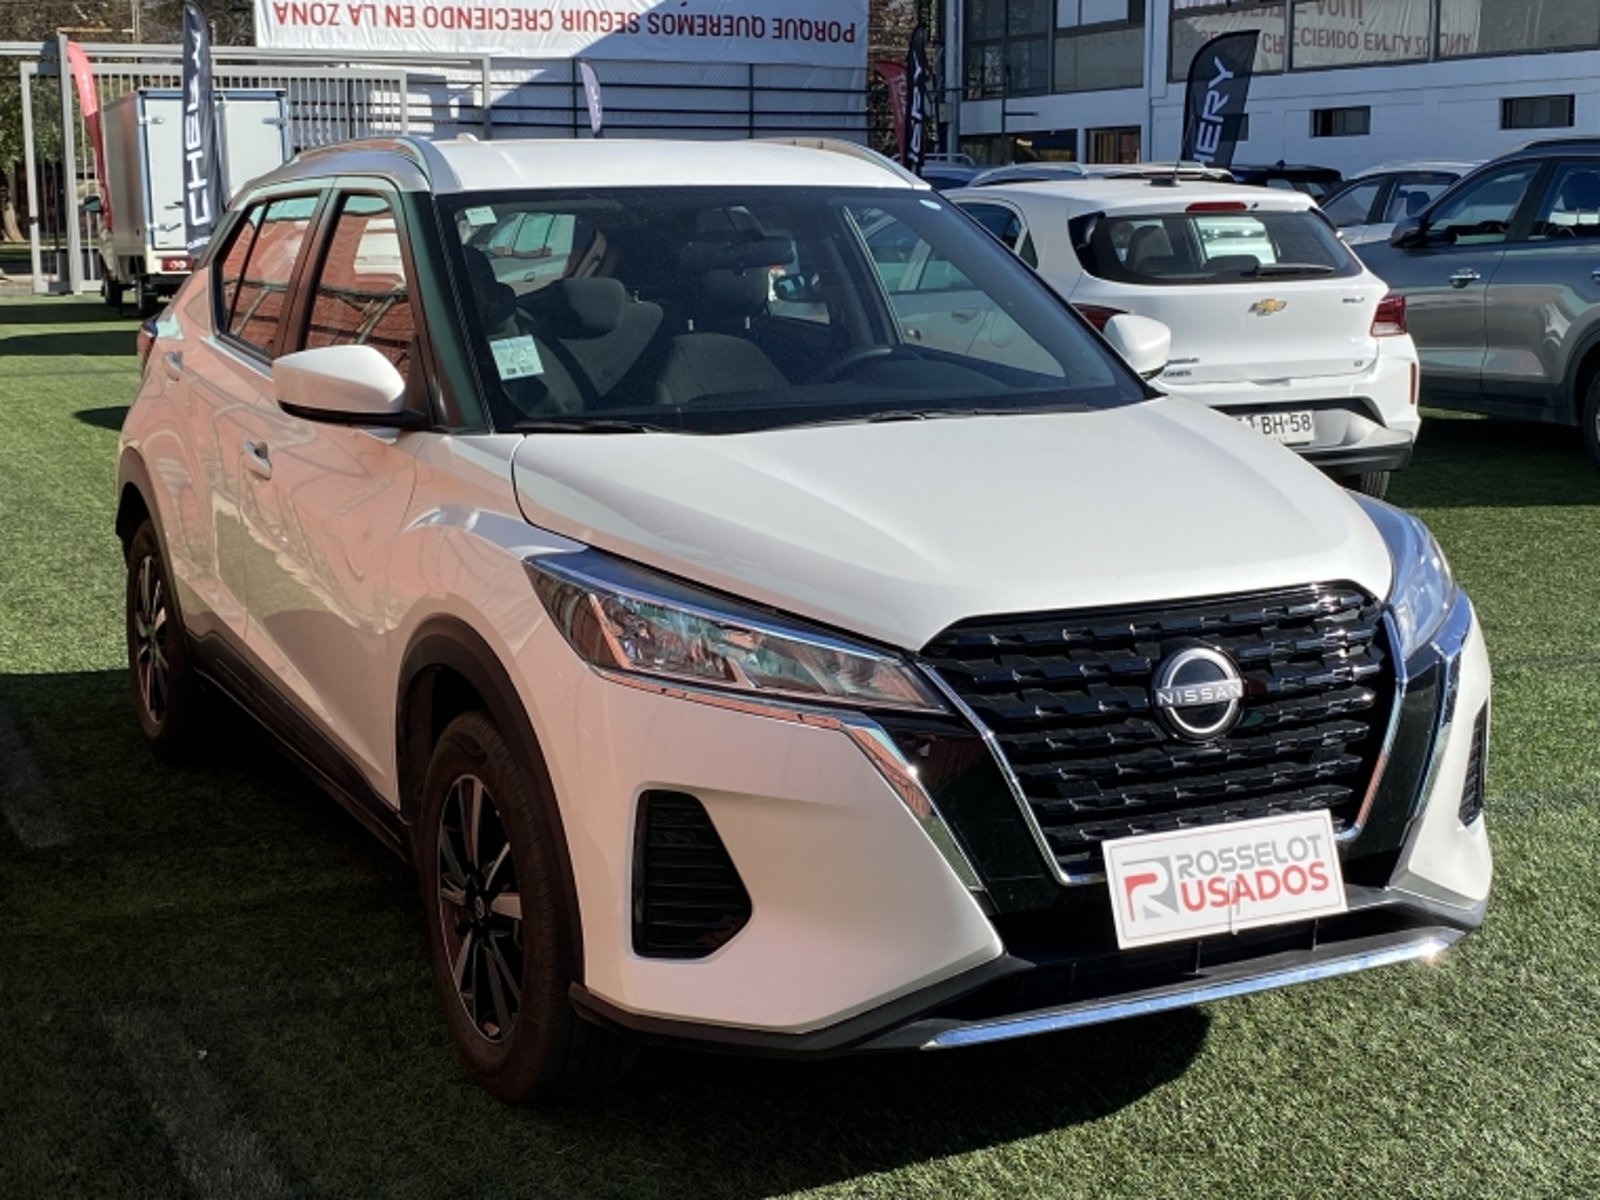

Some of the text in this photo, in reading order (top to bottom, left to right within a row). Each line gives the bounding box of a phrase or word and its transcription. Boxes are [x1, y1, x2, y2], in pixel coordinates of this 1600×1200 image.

[273, 1, 856, 43] PORQUE QUEREMOS SEGUIR CRECIENDO EN LA ZONA
[1157, 682, 1242, 705] NISSAN
[1175, 835, 1322, 879] ROSSELOT
[1180, 861, 1329, 912] USADOS
